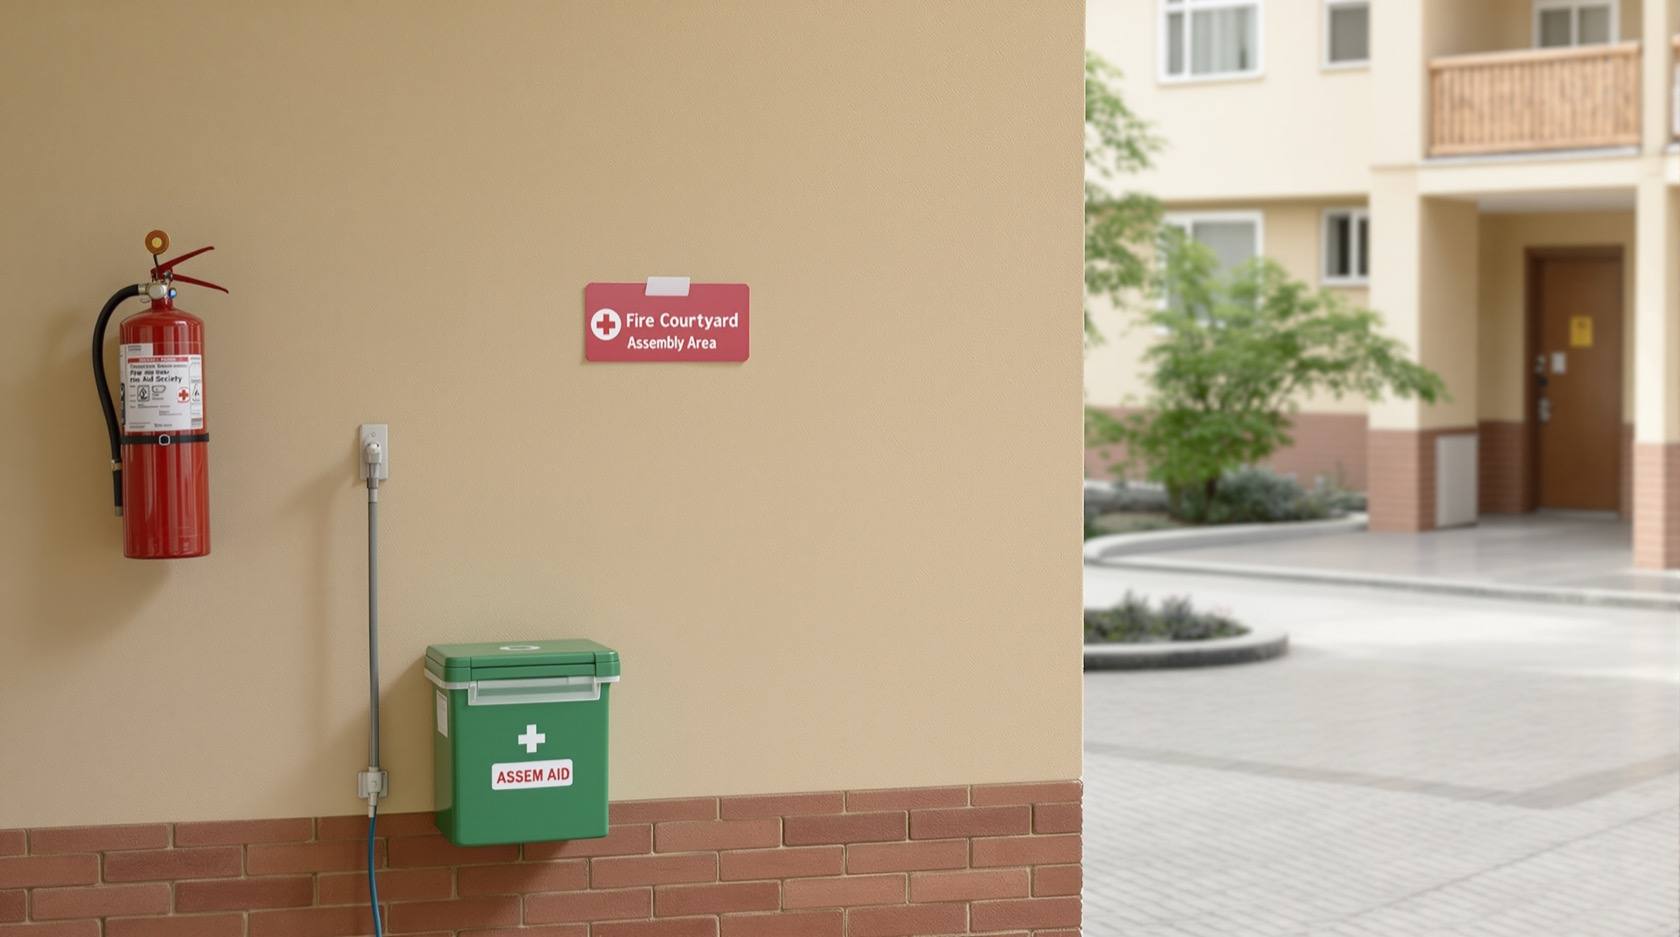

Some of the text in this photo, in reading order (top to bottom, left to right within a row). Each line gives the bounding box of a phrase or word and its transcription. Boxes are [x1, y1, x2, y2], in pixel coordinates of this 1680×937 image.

[626, 312, 739, 330] Fire Courtyard
[627, 336, 717, 352] Assembly Area
[496, 767, 570, 784] ASSEM AID
